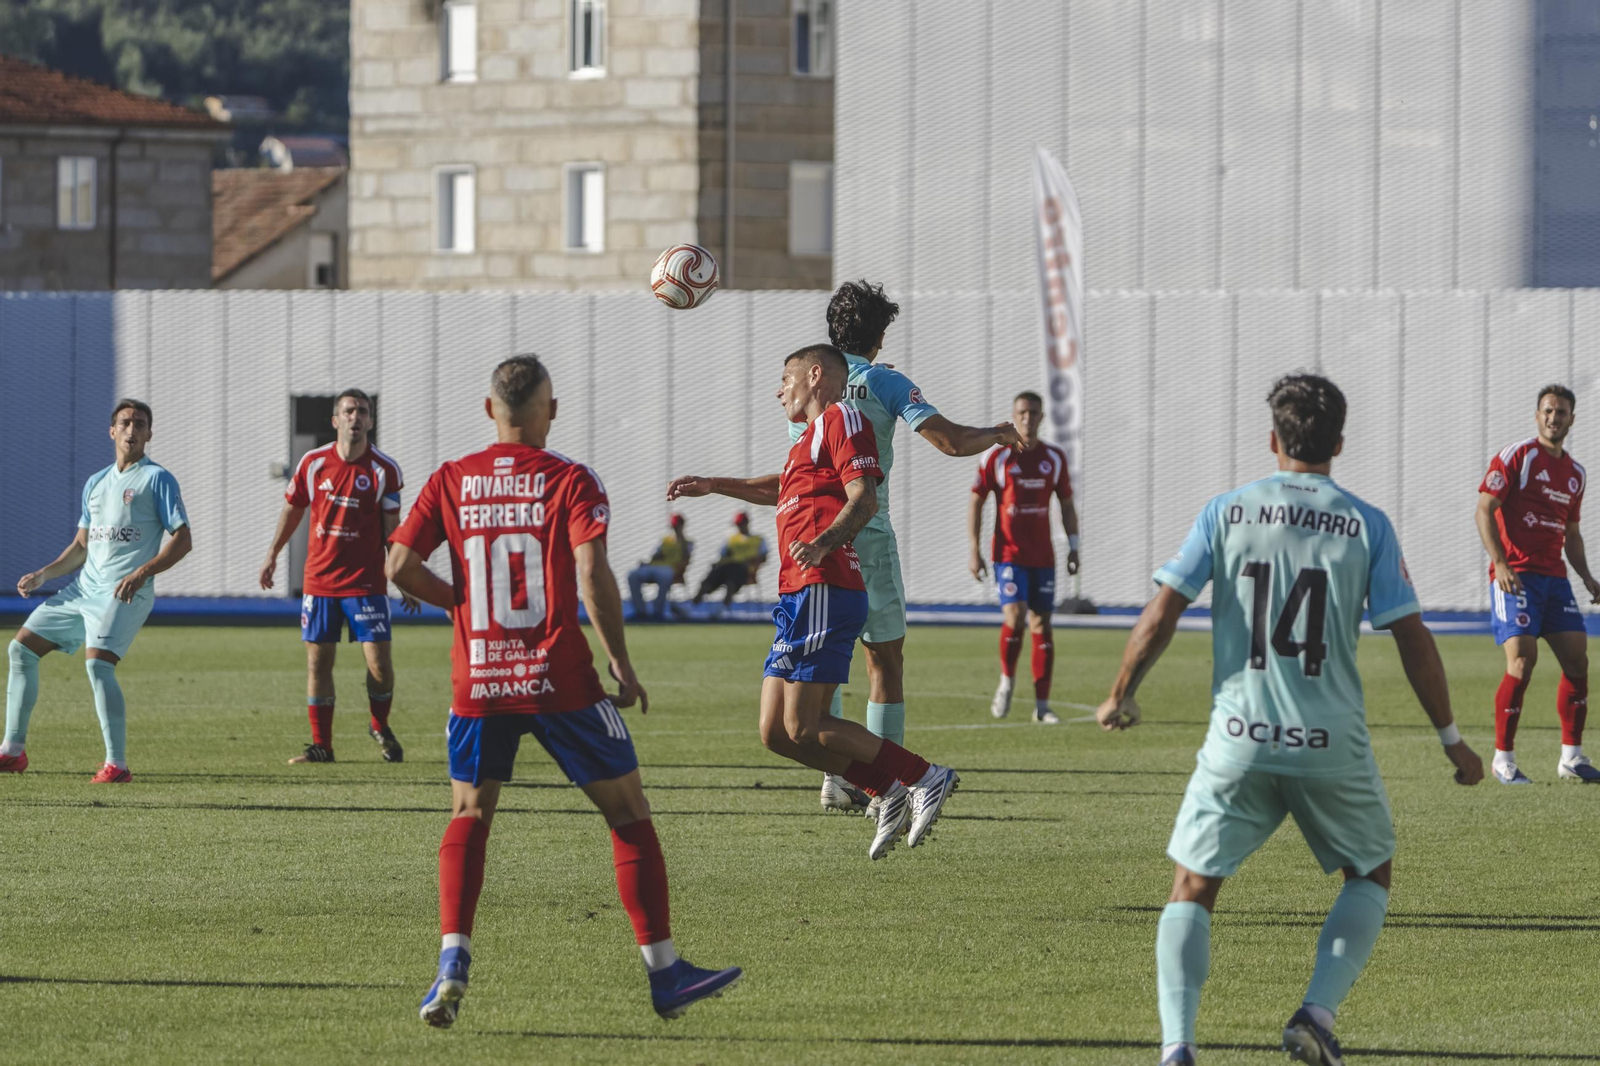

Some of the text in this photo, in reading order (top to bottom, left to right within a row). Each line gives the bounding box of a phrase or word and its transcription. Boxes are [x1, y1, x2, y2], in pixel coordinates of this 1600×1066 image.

[461, 472, 545, 502] POVARELO
[459, 502, 545, 530] FERREIRO
[1230, 505, 1361, 538] D. NAVARRO
[463, 533, 546, 631] 10
[1516, 590, 1528, 609] 5
[1241, 562, 1327, 677] 14
[488, 639, 525, 651] XUNTA
[488, 648, 548, 662] DE GALICIA
[1227, 717, 1329, 749] ocisa
